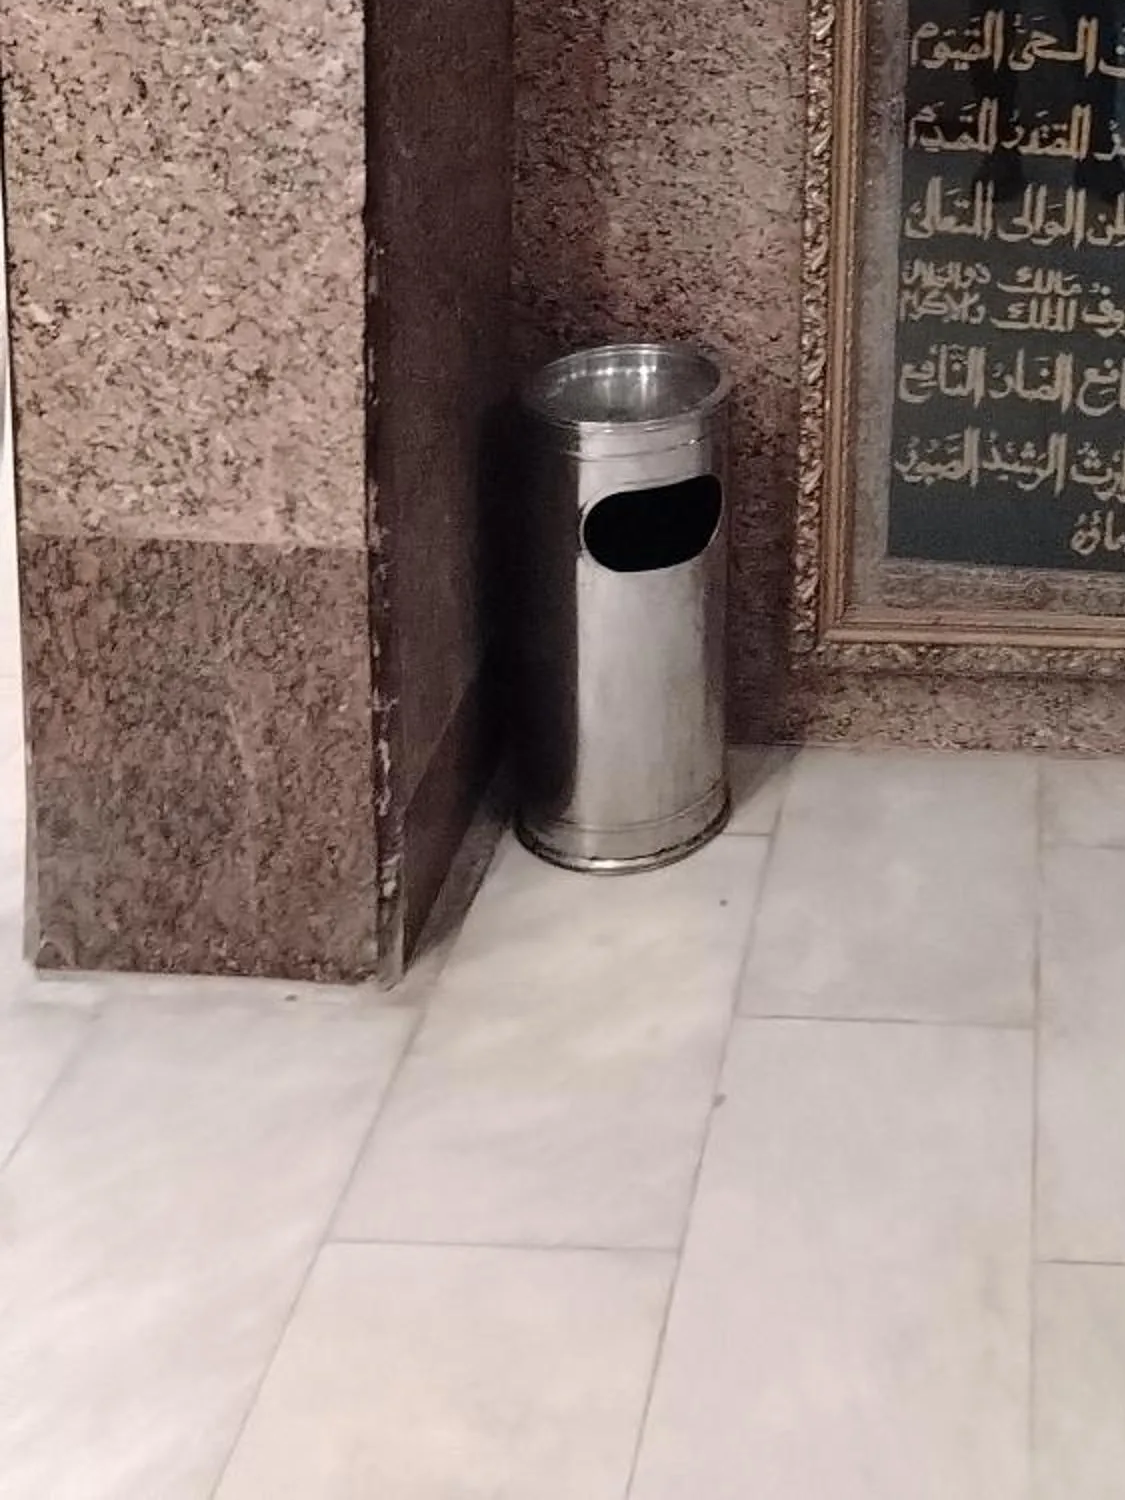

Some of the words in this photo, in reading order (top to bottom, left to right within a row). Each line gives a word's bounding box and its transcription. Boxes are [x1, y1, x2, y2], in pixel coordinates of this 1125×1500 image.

[910, 7, 1004, 71] القيوم
[908, 94, 998, 153] المقدم
[1000, 101, 1092, 158] المقتدر
[900, 344, 986, 405] النافع
[988, 350, 1073, 412] الضار
[895, 423, 981, 487] الصبور
[981, 429, 1068, 495] الرشيد
